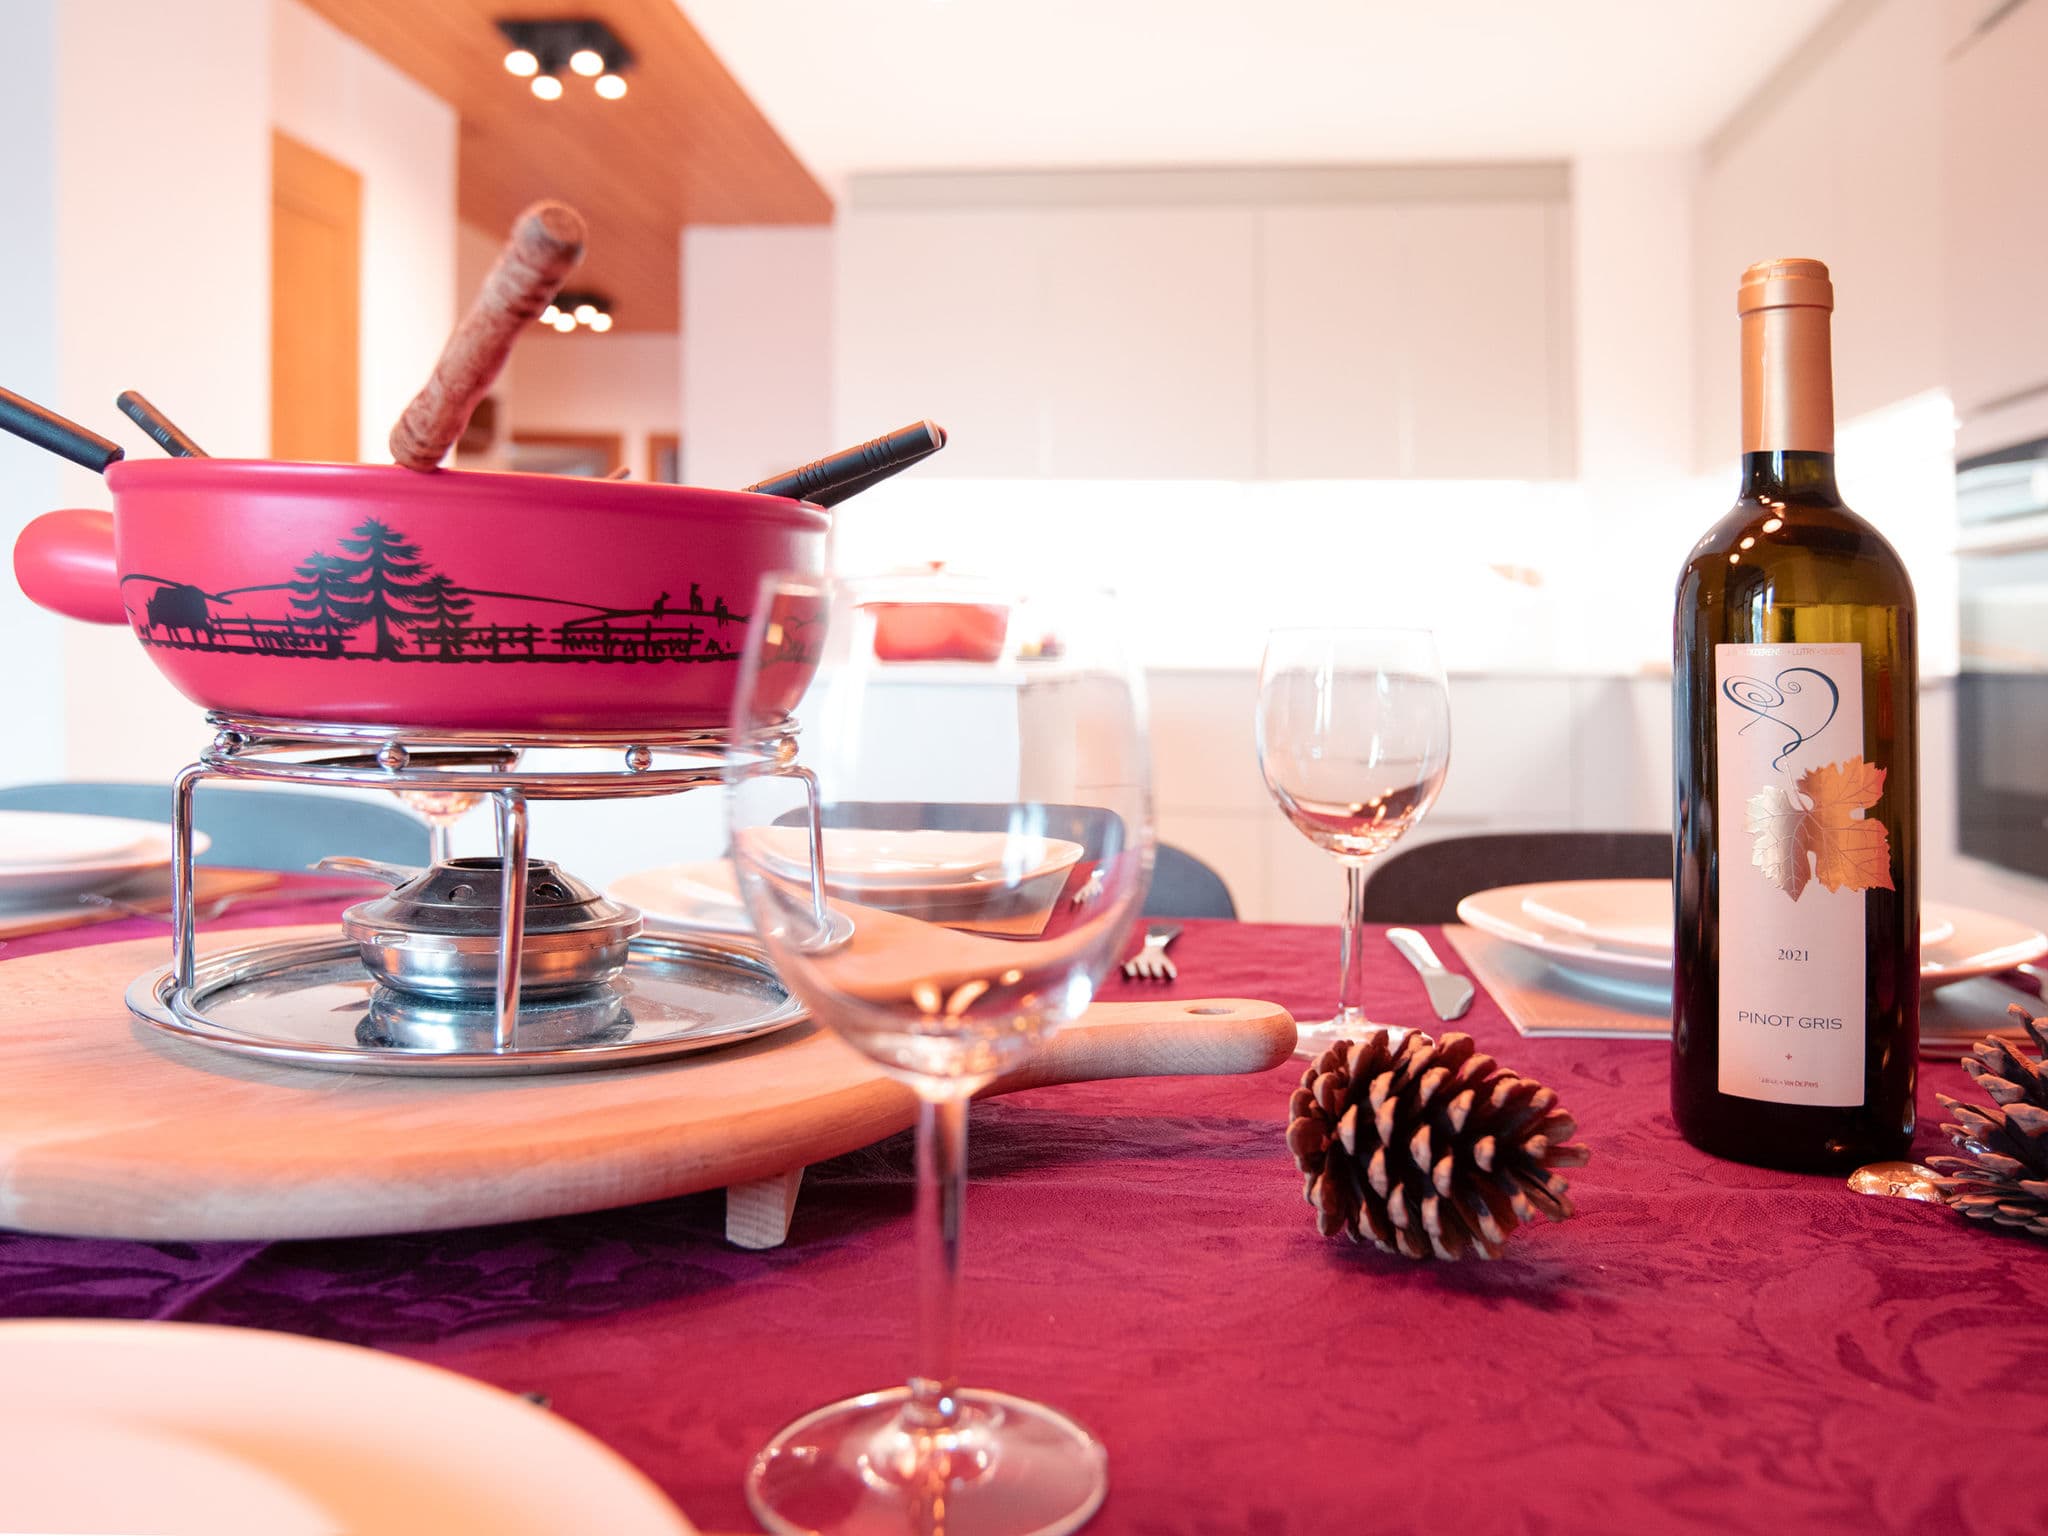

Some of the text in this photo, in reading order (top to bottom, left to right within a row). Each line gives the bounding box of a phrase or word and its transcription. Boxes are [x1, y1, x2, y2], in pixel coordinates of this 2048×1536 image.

[1778, 949, 1809, 962] 2021
[1738, 1011, 1843, 1030] PINOT GRIS
